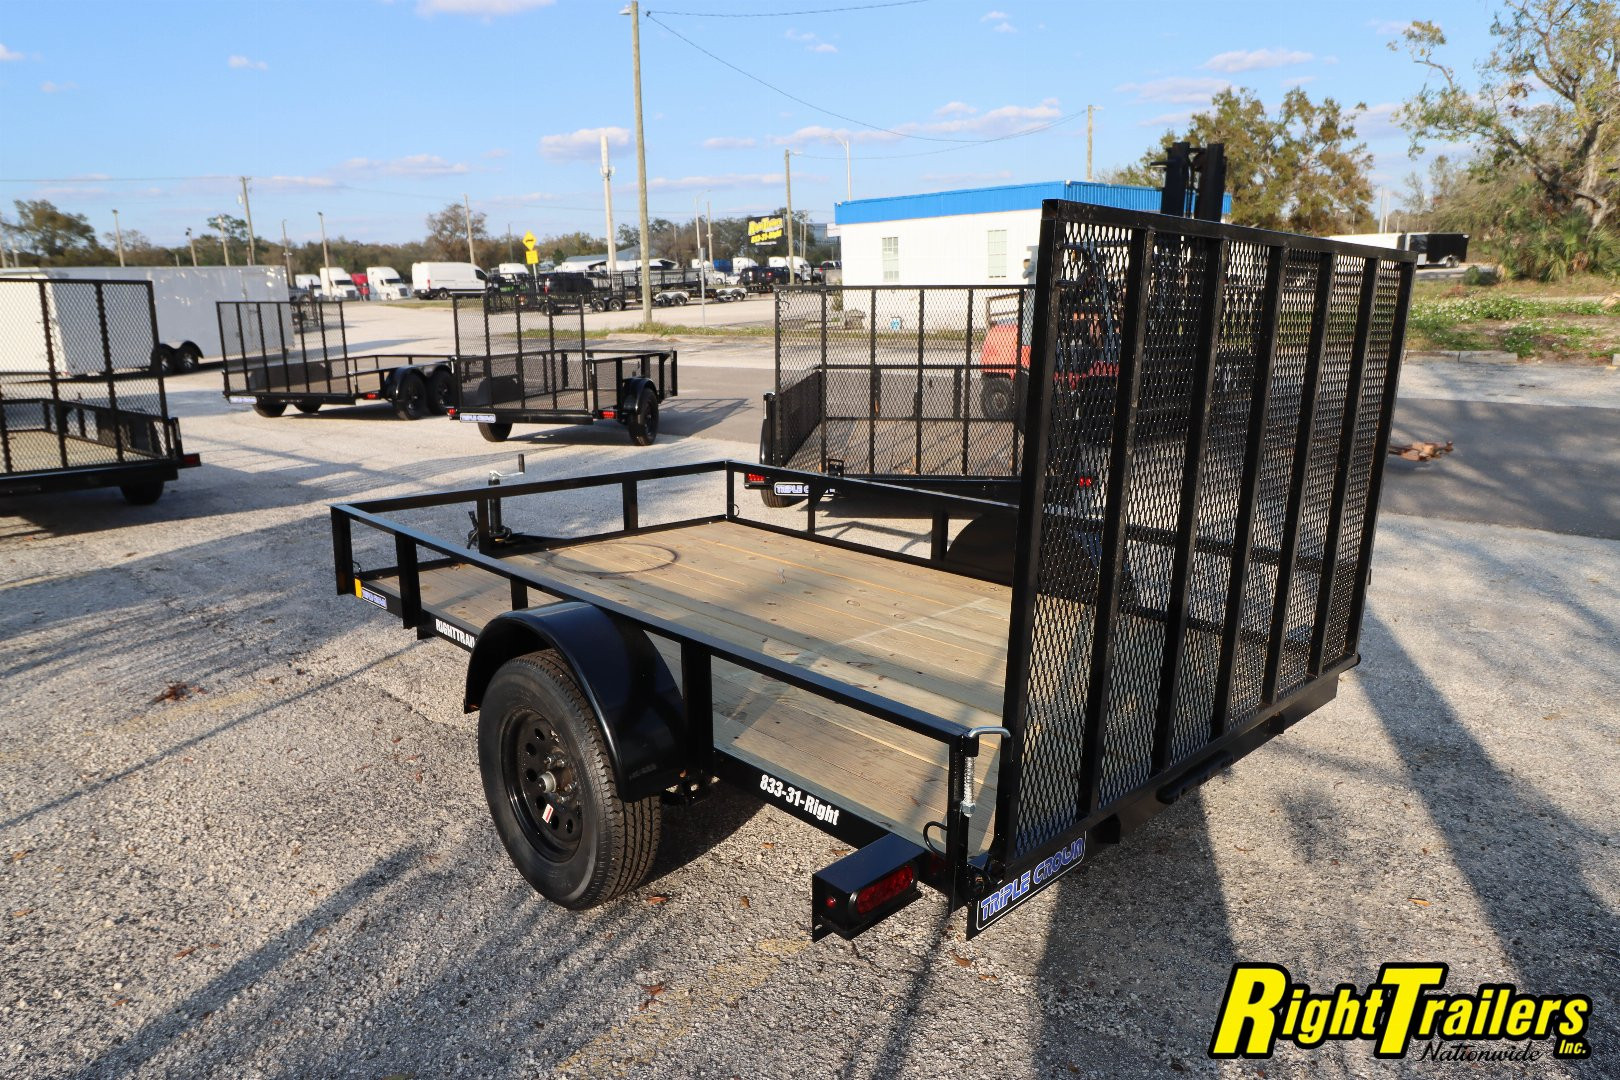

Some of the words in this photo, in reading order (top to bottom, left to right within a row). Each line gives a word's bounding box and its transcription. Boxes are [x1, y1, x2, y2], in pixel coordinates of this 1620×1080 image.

[776, 485, 802, 494] TRIPLE
[759, 774, 840, 826] 833-31-Right
[981, 870, 1031, 921] TRIPLE
[1033, 837, 1084, 884] CROWN
